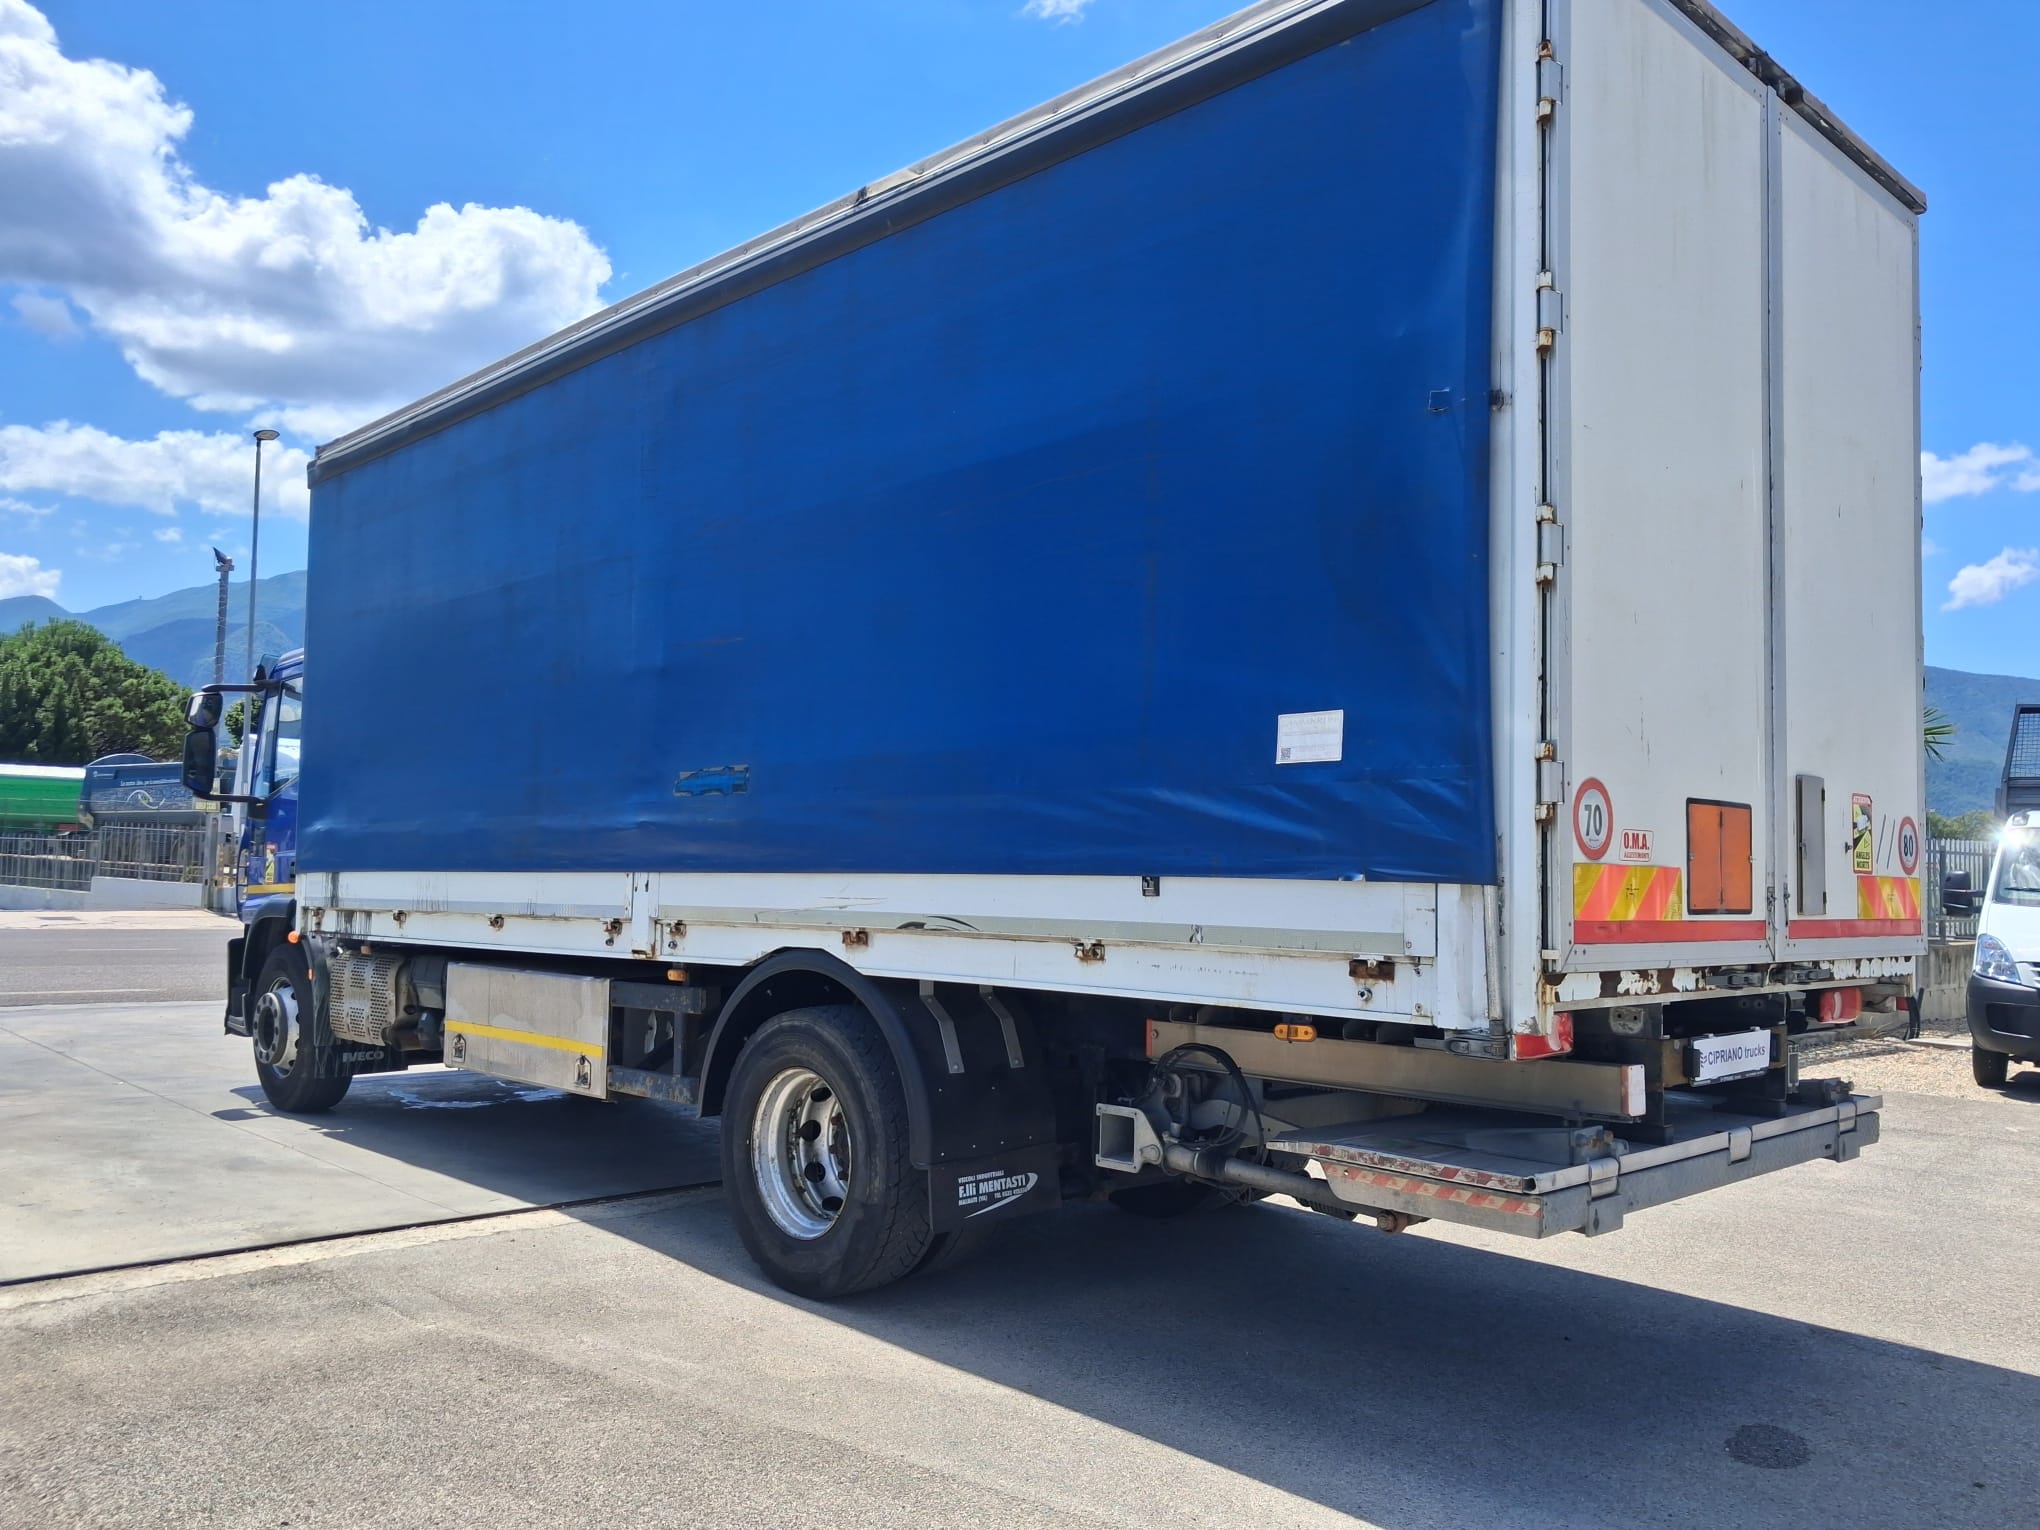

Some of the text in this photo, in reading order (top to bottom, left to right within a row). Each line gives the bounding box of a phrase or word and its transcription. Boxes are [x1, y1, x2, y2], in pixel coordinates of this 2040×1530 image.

[1584, 803, 1603, 837] 70
[1623, 832, 1650, 851] O.M.A.
[1903, 834, 1914, 857] 80
[342, 1050, 385, 1063] IVECO
[1708, 1044, 1766, 1065] CIPRIANO trucks
